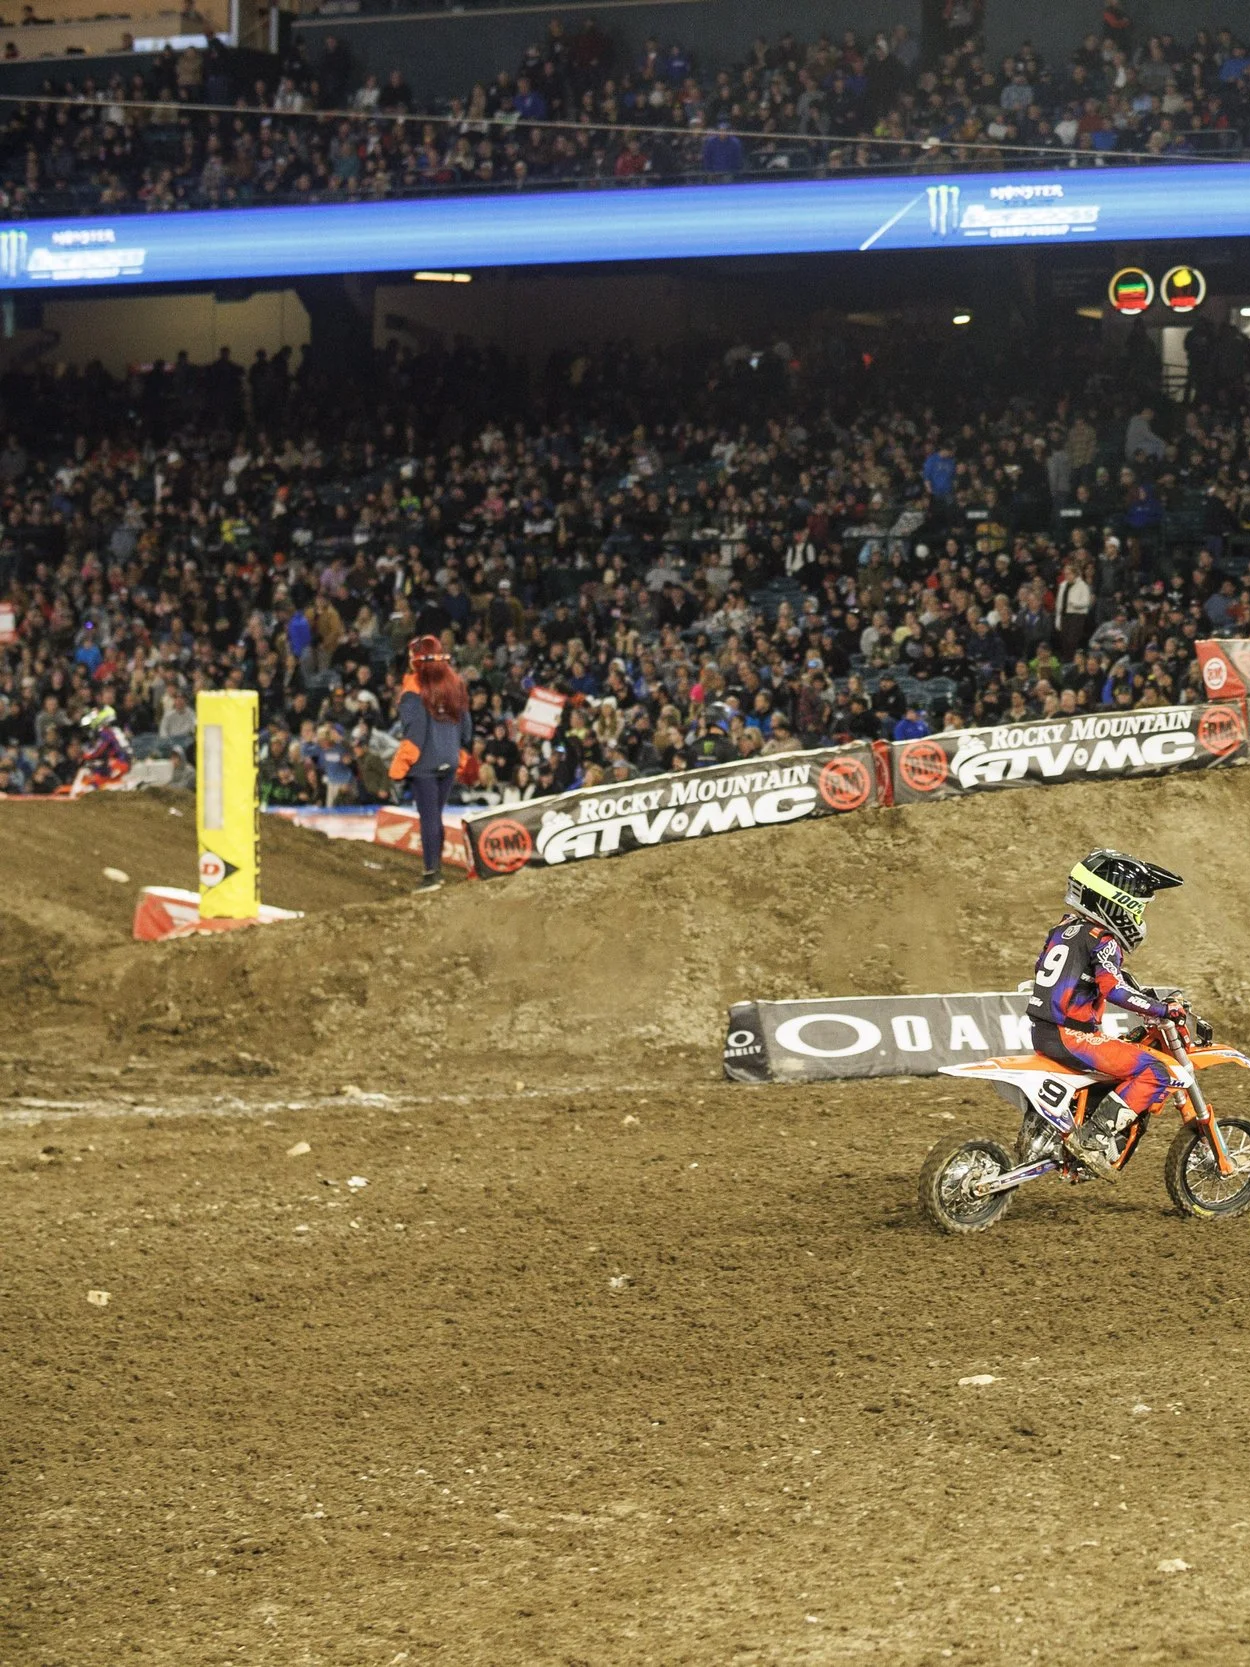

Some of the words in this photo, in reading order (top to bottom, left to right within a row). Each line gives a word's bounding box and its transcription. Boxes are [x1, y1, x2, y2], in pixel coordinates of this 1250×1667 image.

[990, 724, 1065, 750] ROCKY
[1069, 709, 1195, 741] MOUNTAIN
[578, 790, 664, 821] ROCKY
[669, 765, 811, 809] MOUNTAIN
[1036, 944, 1070, 988] 9
